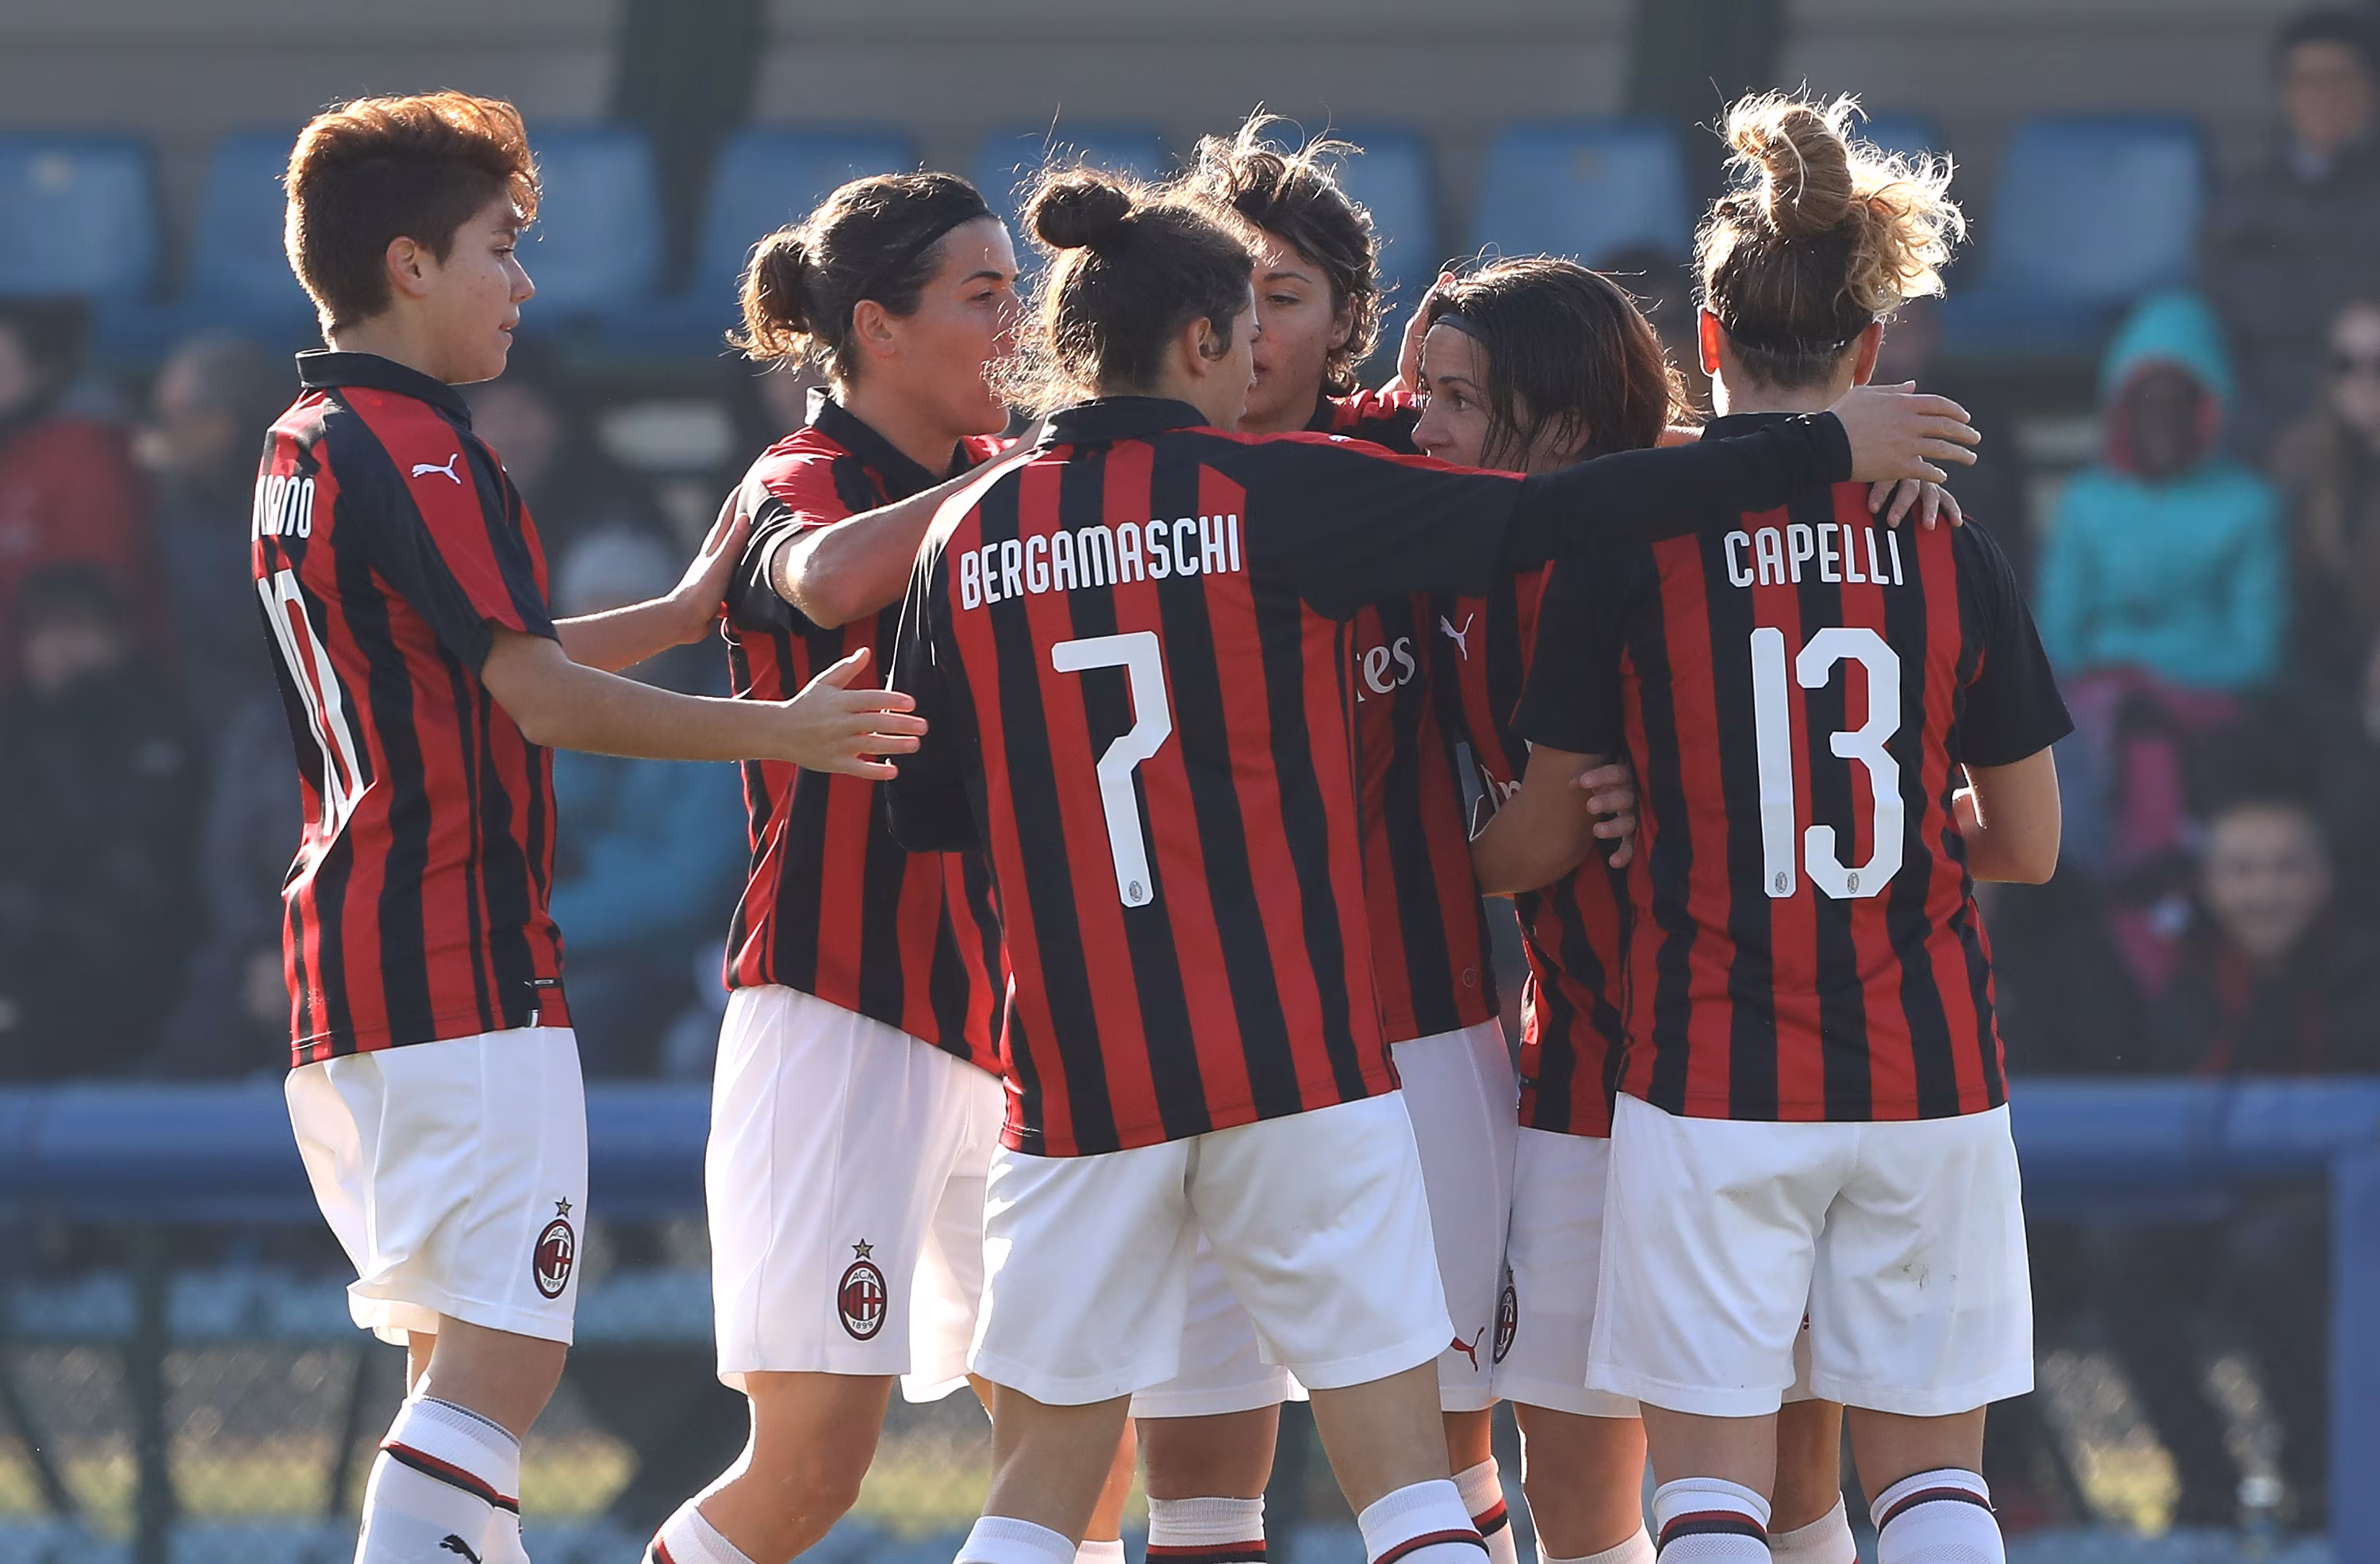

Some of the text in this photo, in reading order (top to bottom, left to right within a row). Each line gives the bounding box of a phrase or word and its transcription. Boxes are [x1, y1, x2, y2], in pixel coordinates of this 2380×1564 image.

[960, 514, 1241, 611] BERGAMASCHI
[1723, 523, 1904, 588] CAPELLI
[1356, 636, 1415, 703] es
[1050, 630, 1173, 908] 7
[1749, 627, 1905, 899] 13
[542, 1277, 562, 1289] 1899
[850, 1269, 877, 1284] ACM
[851, 1320, 874, 1330] 1899
